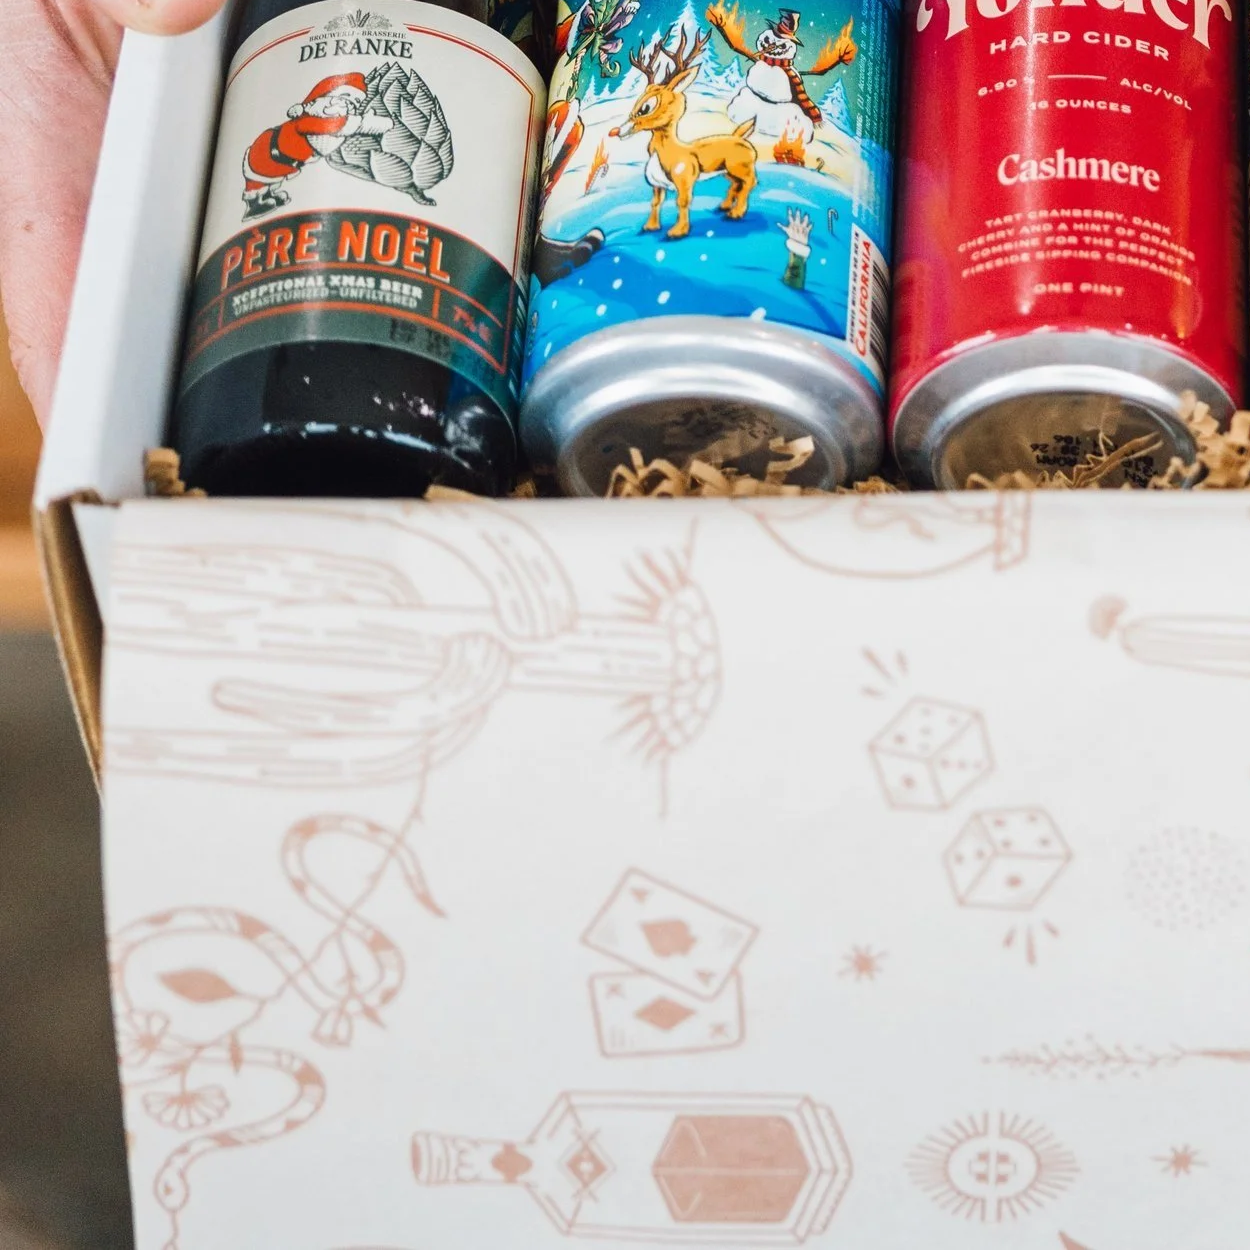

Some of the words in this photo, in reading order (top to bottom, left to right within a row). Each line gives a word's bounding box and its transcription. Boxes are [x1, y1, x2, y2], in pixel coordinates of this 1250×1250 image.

[299, 41, 328, 63] DE
[333, 38, 413, 59] RANKE
[362, 31, 407, 40] BRASSERIE
[989, 31, 1071, 55] HARD
[1083, 31, 1170, 61] CIDER
[977, 78, 1018, 97] 6.90
[1119, 77, 1193, 111] ALC/VOL
[1055, 99, 1132, 114] OUNCES
[997, 148, 1161, 193] Cashmere
[985, 213, 1022, 228] TART
[1027, 209, 1128, 224] CRANBERRY,
[1132, 216, 1171, 236] DARK
[221, 222, 322, 291] PÈRE
[337, 220, 450, 283] NOËL
[958, 228, 1015, 253] CHERRY
[1020, 223, 1053, 235] AND
[1057, 222, 1069, 231] A
[1073, 222, 1111, 233] HINT
[1115, 226, 1136, 237] OF
[1140, 232, 1195, 262] ORANGE
[971, 237, 1040, 261] COMBINE
[1045, 235, 1078, 245] FOR
[1083, 236, 1114, 248] THE
[1119, 240, 1183, 266] PERFECT
[962, 252, 1031, 278] FIRESIDE
[1036, 249, 1102, 262] SIPPING
[1105, 252, 1192, 286] COMPANION
[328, 274, 375, 289] XMAS
[380, 278, 424, 300] BEER
[855, 240, 871, 357] CALIFORNIA
[1034, 282, 1074, 294] ONE
[1080, 282, 1125, 297] PINT
